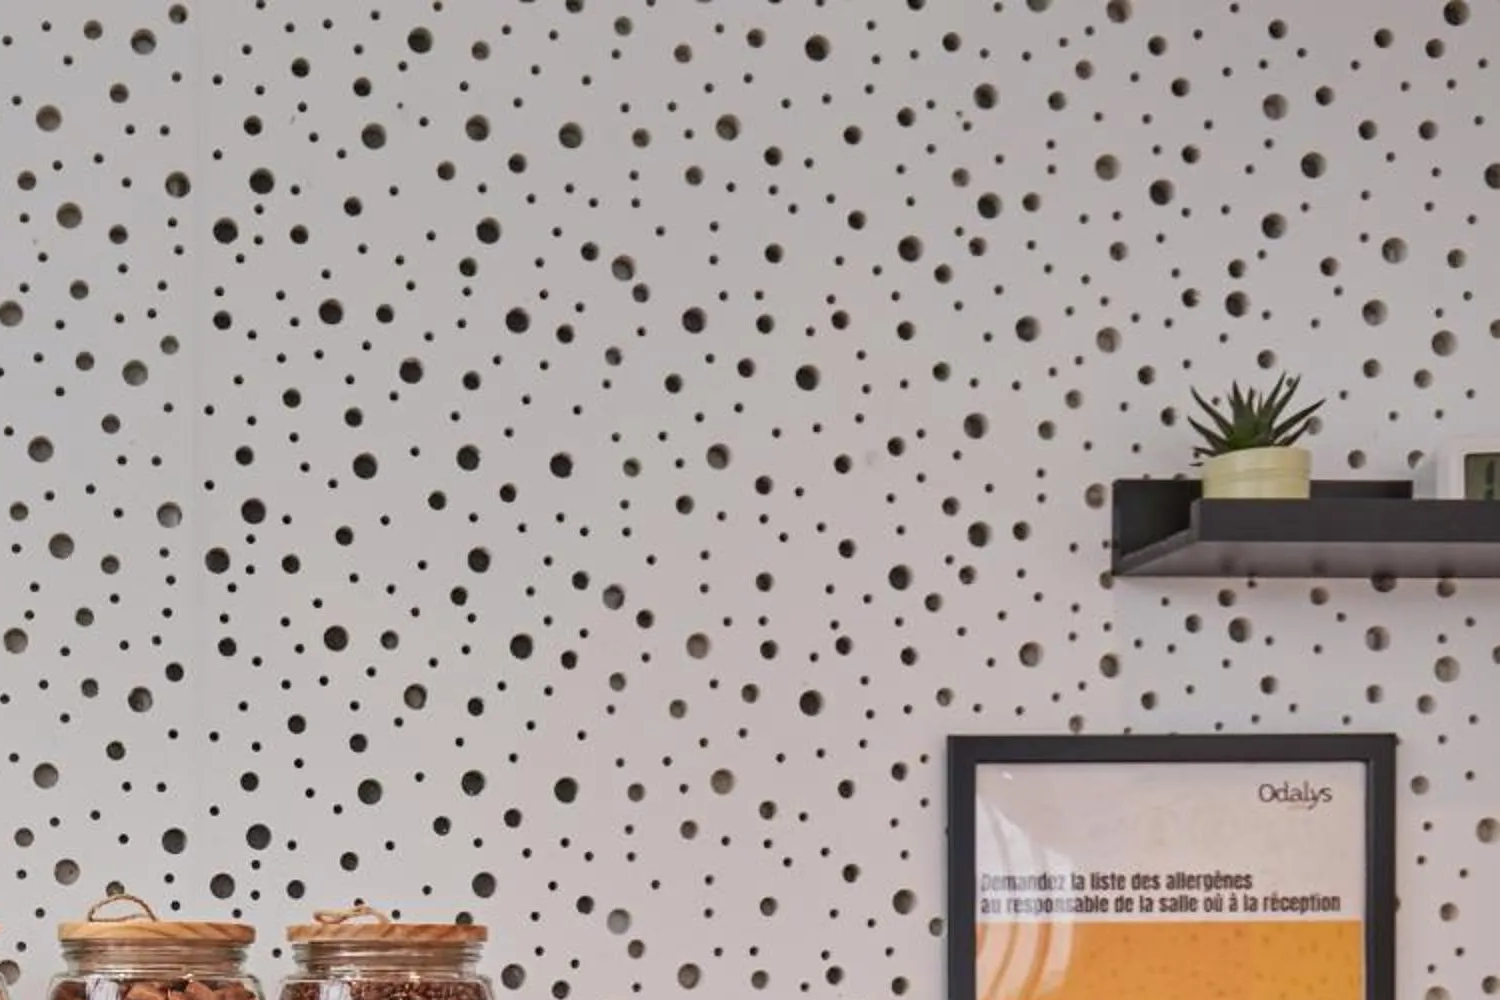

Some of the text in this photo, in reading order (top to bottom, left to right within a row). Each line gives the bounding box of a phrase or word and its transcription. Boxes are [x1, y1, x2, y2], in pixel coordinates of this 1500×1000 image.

[1258, 780, 1333, 810] Odalys
[980, 872, 1065, 891] Demandez
[1071, 872, 1086, 890] la
[1090, 871, 1126, 890] liste
[1131, 872, 1161, 890] des
[1114, 895, 1134, 913] de
[1139, 895, 1153, 913] la
[1159, 894, 1198, 913] salle
[1243, 894, 1258, 912] la
[1263, 891, 1341, 915] réception
